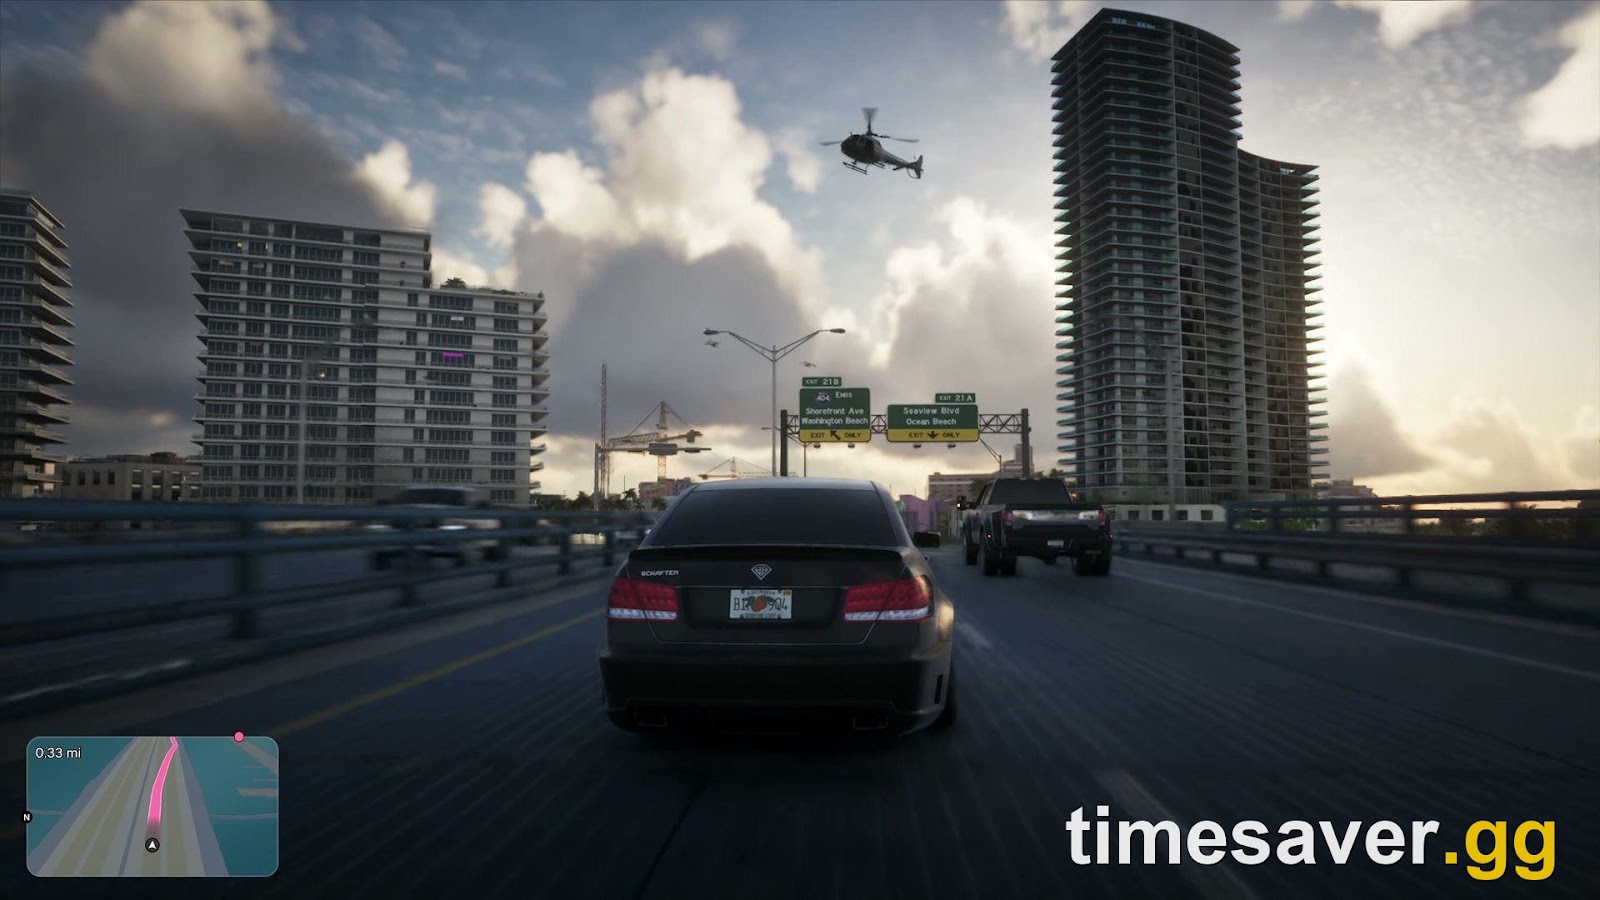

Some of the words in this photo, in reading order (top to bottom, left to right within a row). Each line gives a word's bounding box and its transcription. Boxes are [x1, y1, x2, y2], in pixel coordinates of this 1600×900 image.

[822, 378, 839, 386] 21B
[816, 394, 830, 402] 404
[955, 394, 974, 402] 21A
[805, 407, 845, 415] Shorefront
[848, 407, 865, 415] Ave
[903, 407, 938, 415] Seaview
[941, 407, 960, 415] Blvd
[801, 417, 843, 426] Washington
[845, 417, 869, 425] Beach
[905, 418, 930, 426] Ocean
[932, 418, 957, 426] Beach
